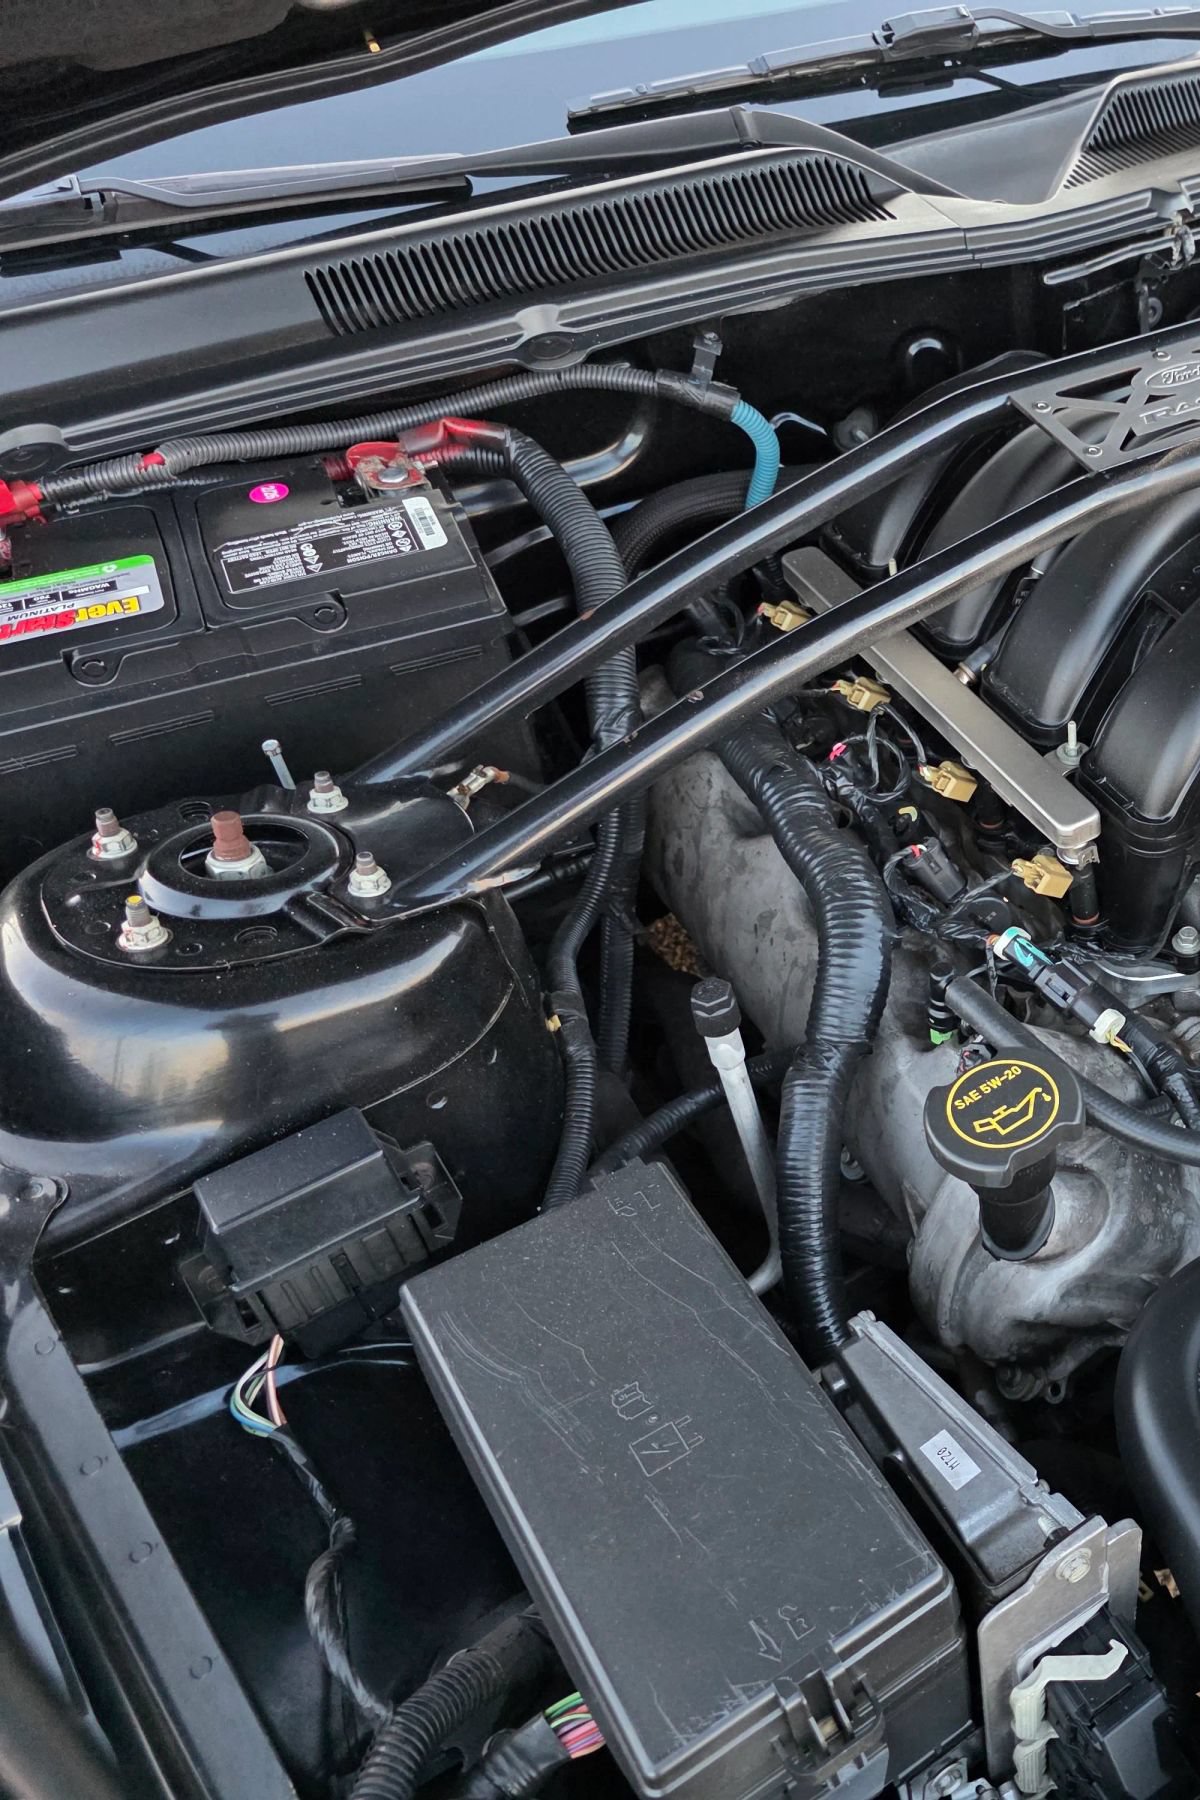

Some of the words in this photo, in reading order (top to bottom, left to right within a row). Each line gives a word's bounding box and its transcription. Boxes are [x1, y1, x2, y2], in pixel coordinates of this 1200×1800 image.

[7, 603, 75, 621] PLATINUM
[954, 1089, 982, 1110] SAE
[979, 1065, 1022, 1094] 5W-20
